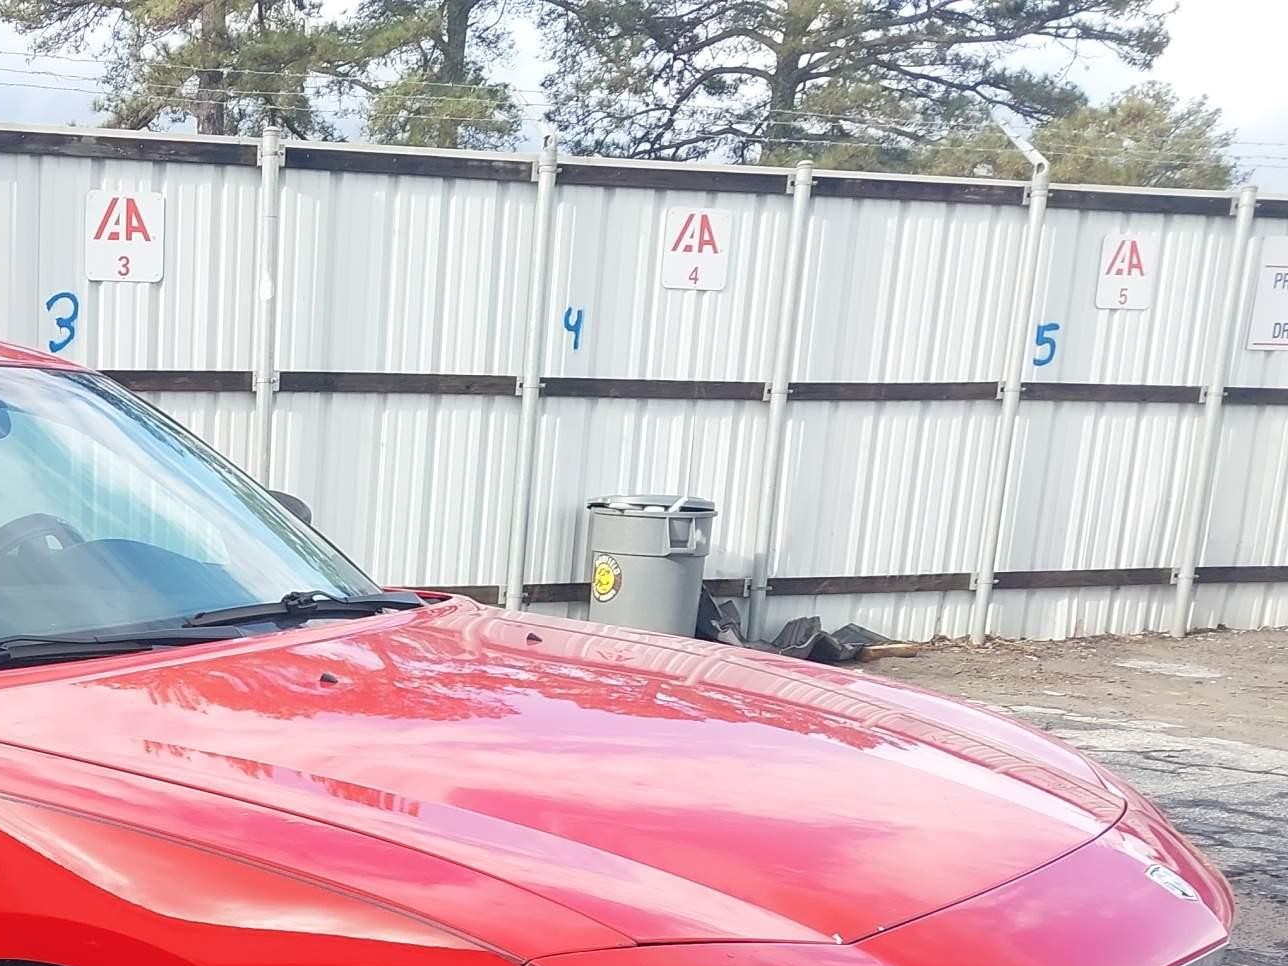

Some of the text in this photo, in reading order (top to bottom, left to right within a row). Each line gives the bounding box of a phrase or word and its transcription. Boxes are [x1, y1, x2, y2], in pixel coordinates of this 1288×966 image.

[118, 255, 130, 276] 3
[688, 266, 700, 285] 4
[1118, 288, 1128, 305] 5
[46, 291, 79, 353] 3
[564, 307, 583, 350] 4
[1033, 323, 1060, 366] 5
